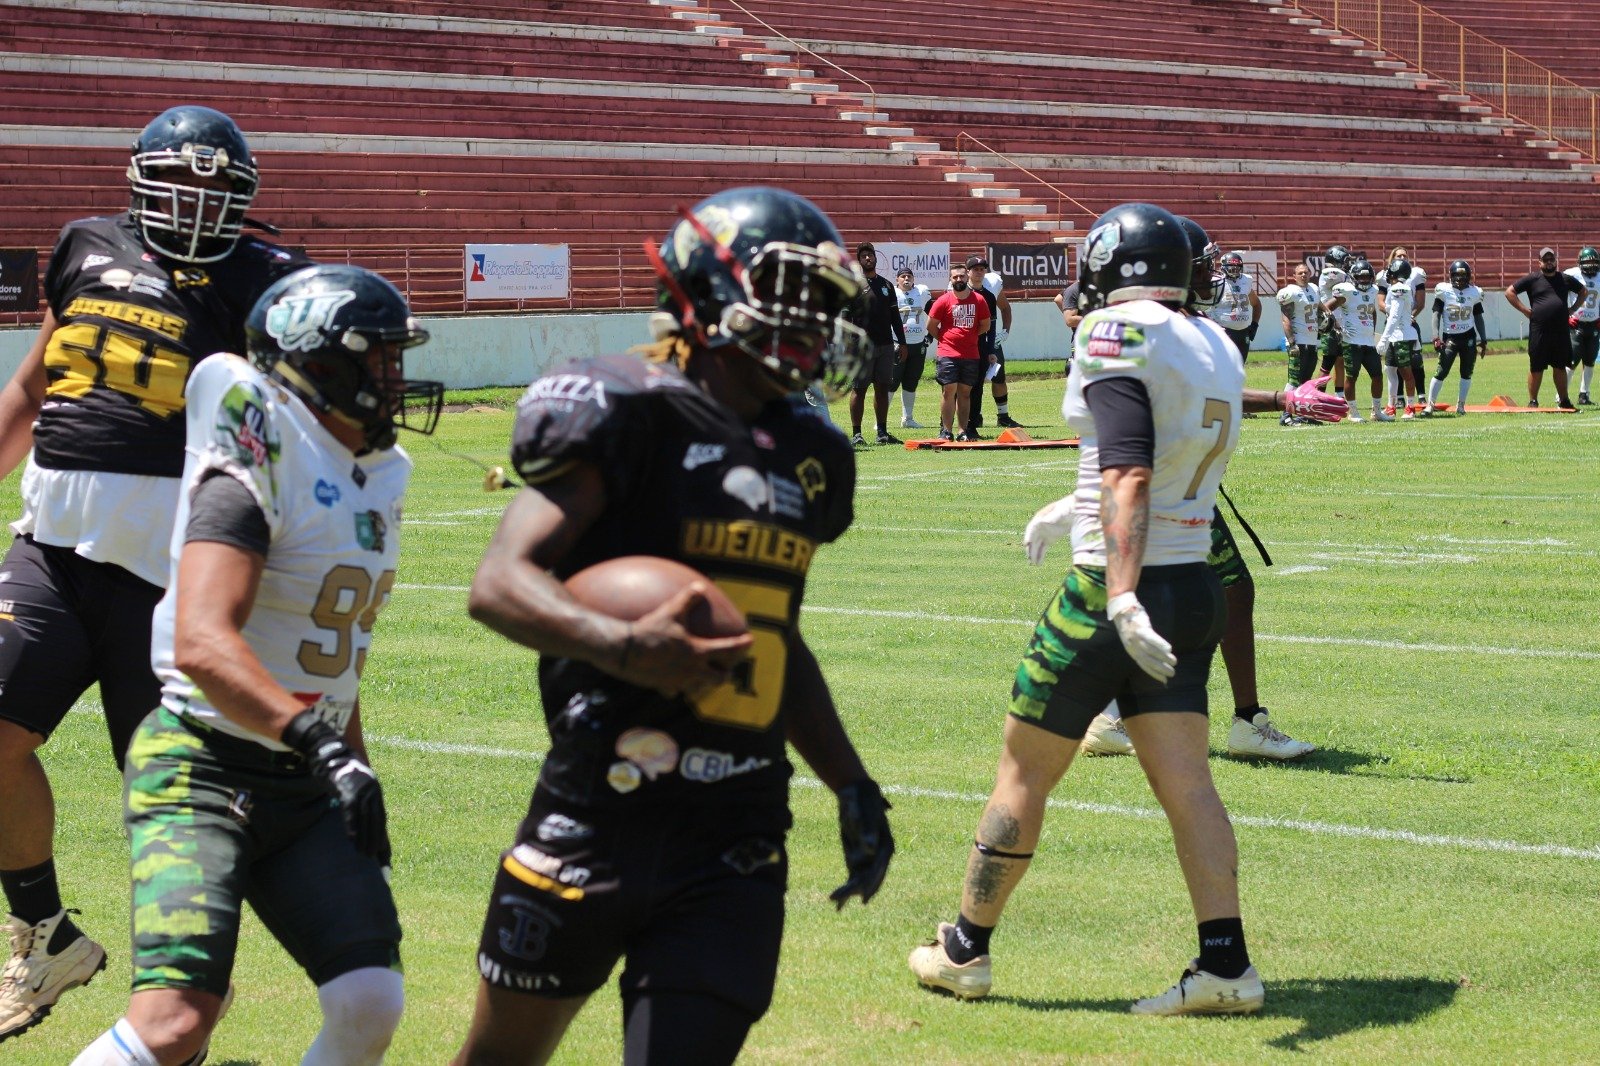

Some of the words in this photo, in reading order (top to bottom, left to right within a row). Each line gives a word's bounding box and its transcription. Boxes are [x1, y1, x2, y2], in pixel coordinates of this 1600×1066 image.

[916, 255, 949, 271] MIAMI
[1091, 321, 1120, 341] ALL
[1182, 397, 1232, 500] 7
